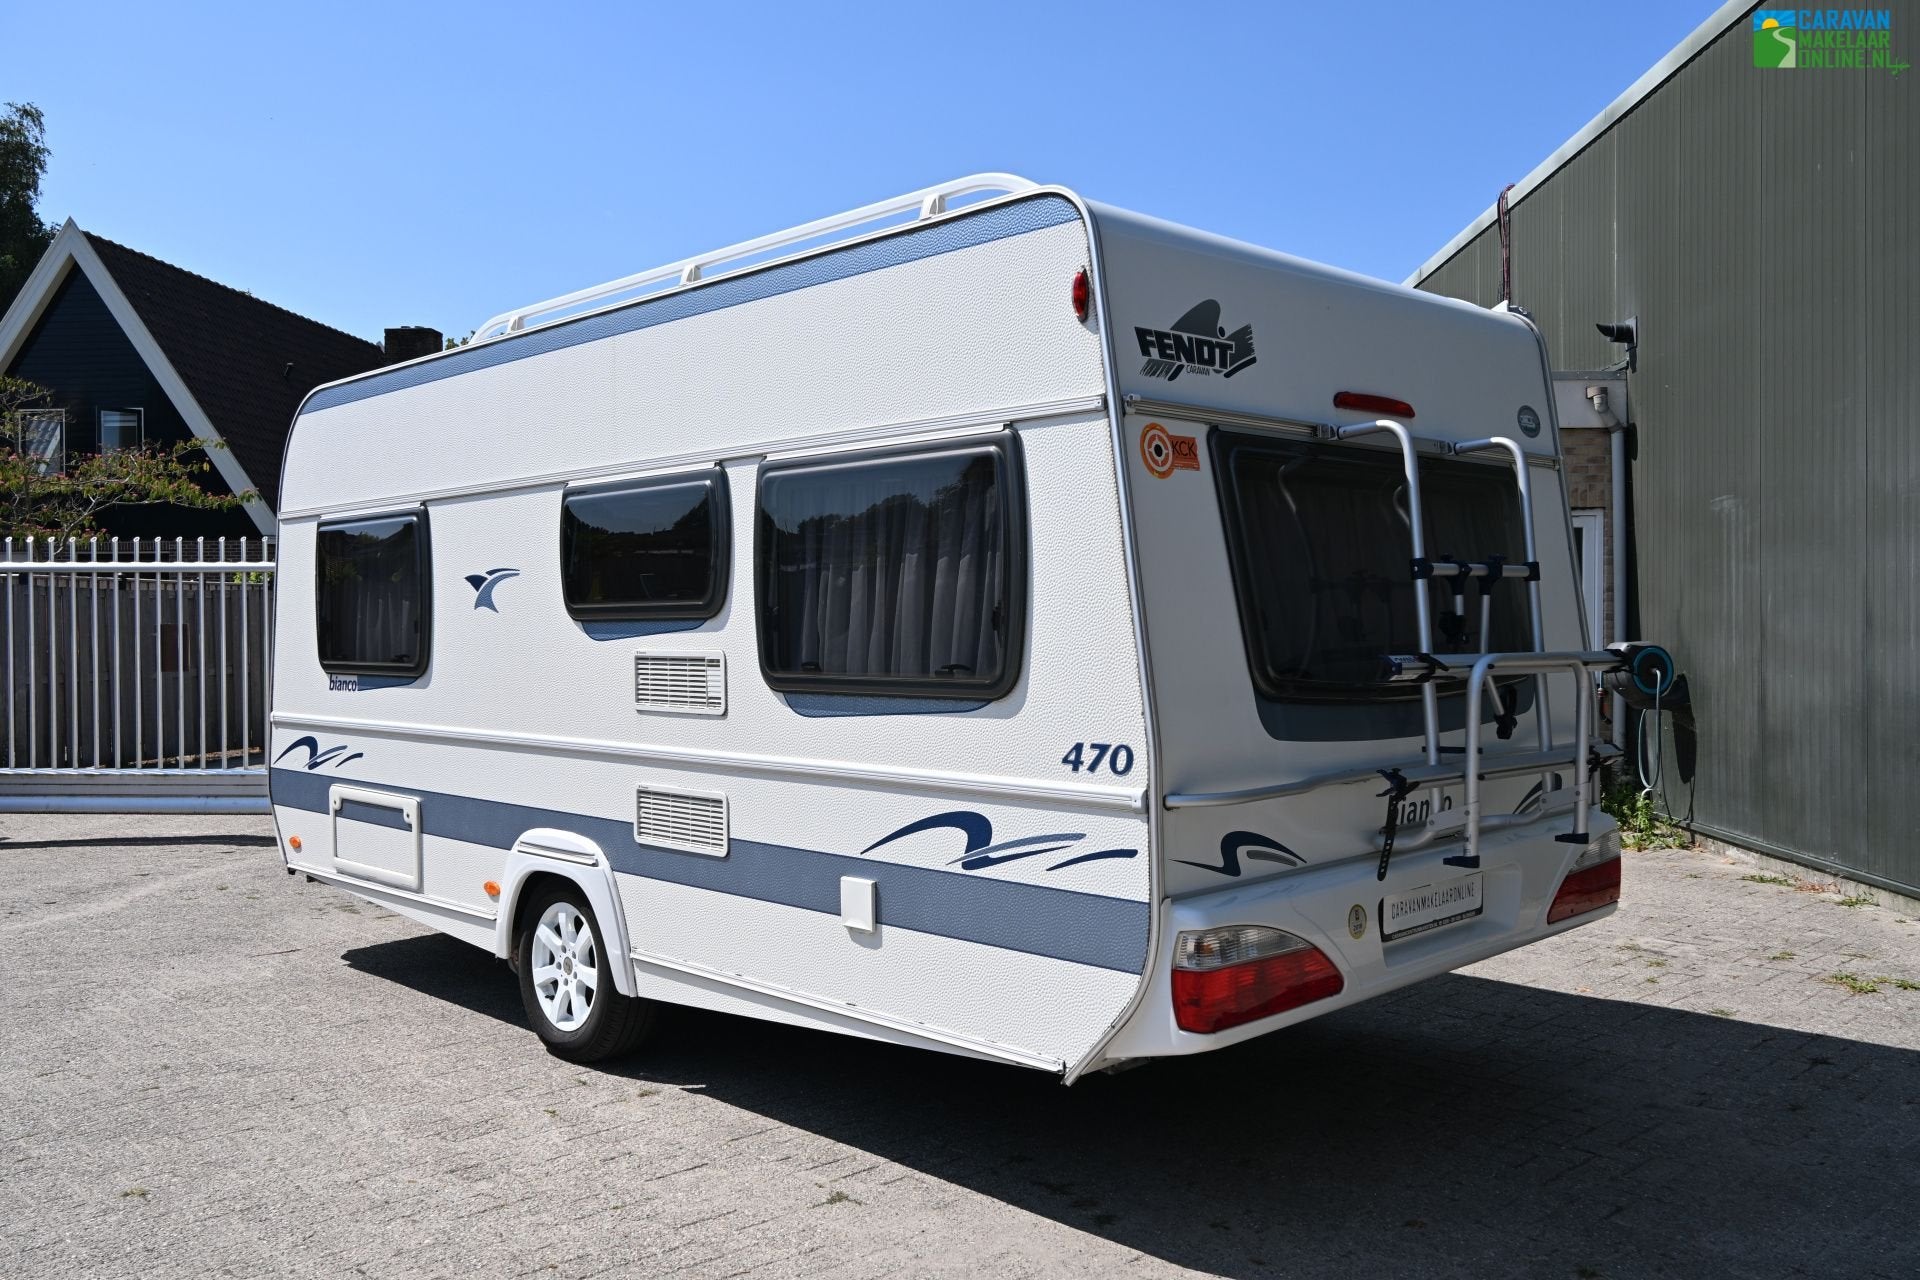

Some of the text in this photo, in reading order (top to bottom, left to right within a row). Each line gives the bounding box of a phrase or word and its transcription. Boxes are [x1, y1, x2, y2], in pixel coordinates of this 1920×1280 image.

[1134, 326, 1234, 370] FENDT
[1171, 440, 1197, 458] KCK
[329, 672, 357, 691] bianco
[1061, 742, 1134, 776] 470
